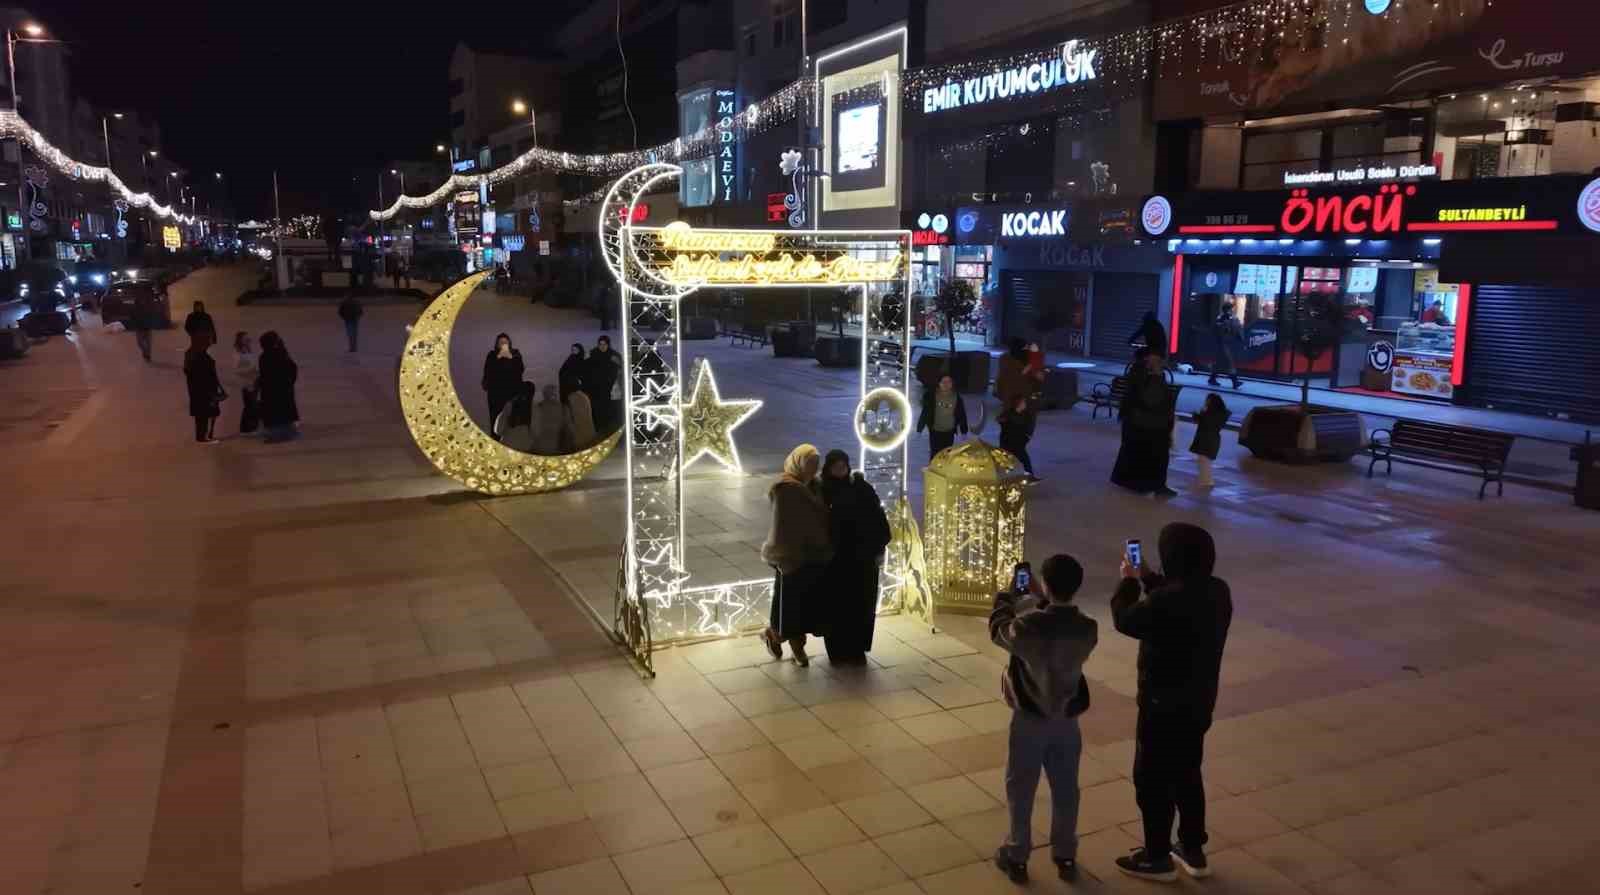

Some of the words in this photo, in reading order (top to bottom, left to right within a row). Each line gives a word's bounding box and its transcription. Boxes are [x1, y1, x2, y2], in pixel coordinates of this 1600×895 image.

[924, 78, 961, 113] EMİR
[963, 49, 1097, 104] KUYUMCULUK
[1438, 205, 1526, 221] SULTANBEYLİ
